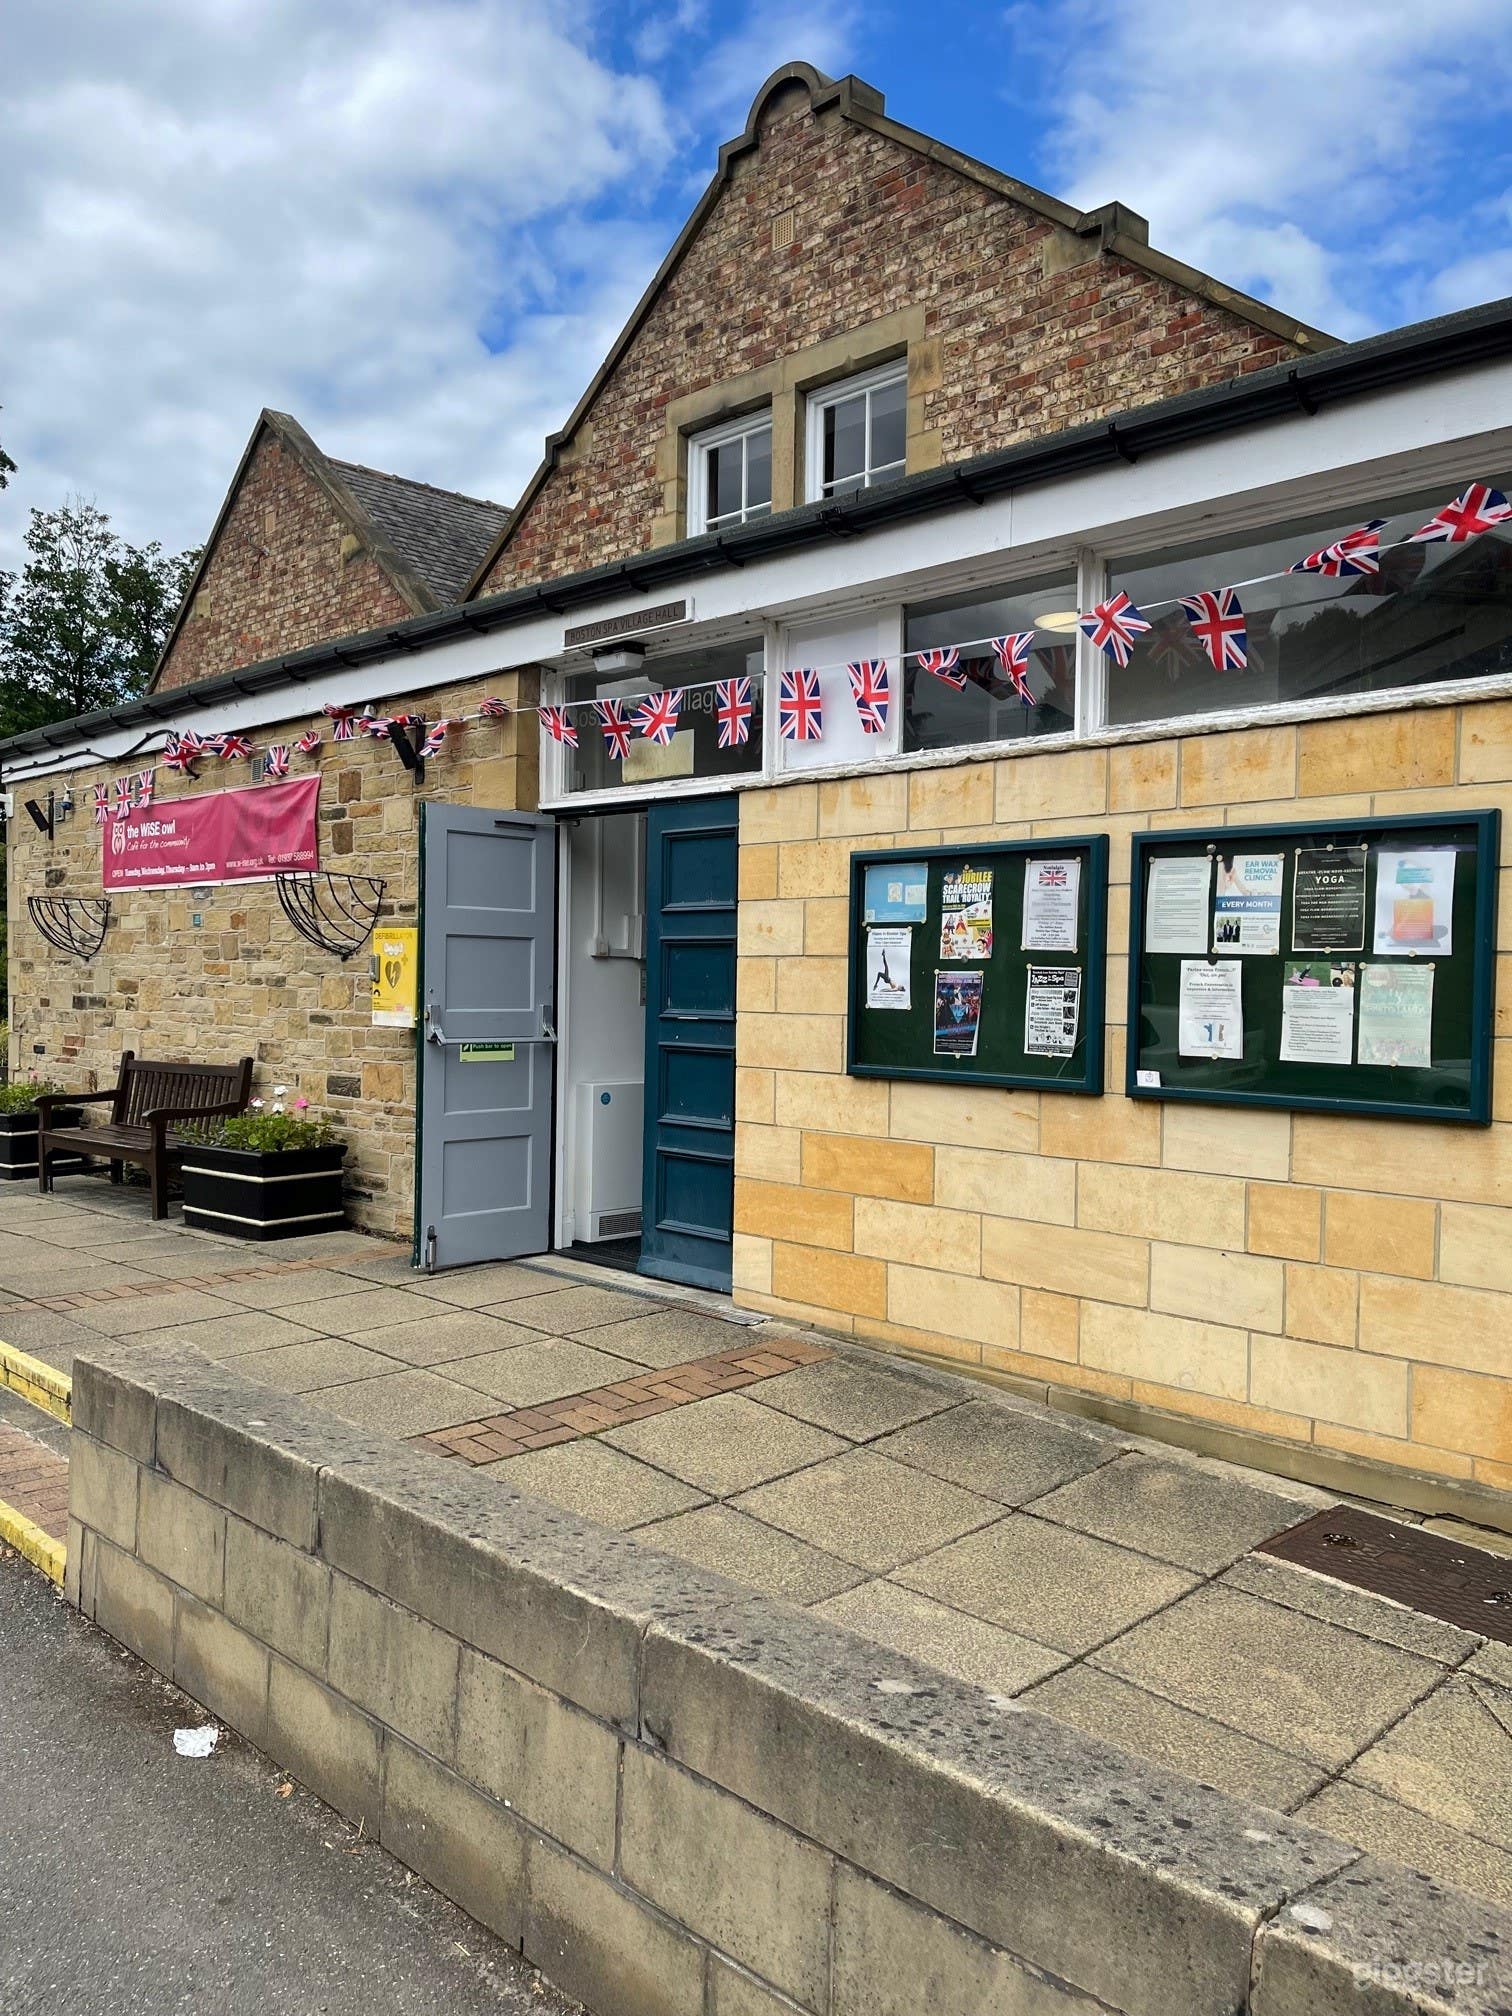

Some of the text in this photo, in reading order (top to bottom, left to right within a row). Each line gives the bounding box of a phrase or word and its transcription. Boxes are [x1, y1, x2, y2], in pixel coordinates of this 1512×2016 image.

[570, 606, 679, 642] BOSTON SPA VILLAGE HALL
[127, 819, 176, 839] the WiSE owl
[139, 839, 148, 851] for
[149, 839, 159, 849] the
[160, 835, 191, 851] community
[1245, 860, 1279, 868] EAR WAX
[961, 871, 993, 884] JUBILEE
[1315, 875, 1345, 884] YOGA
[942, 882, 992, 895] SCARECROW
[942, 893, 960, 904] TRAIL
[1245, 900, 1273, 908] MONTH
